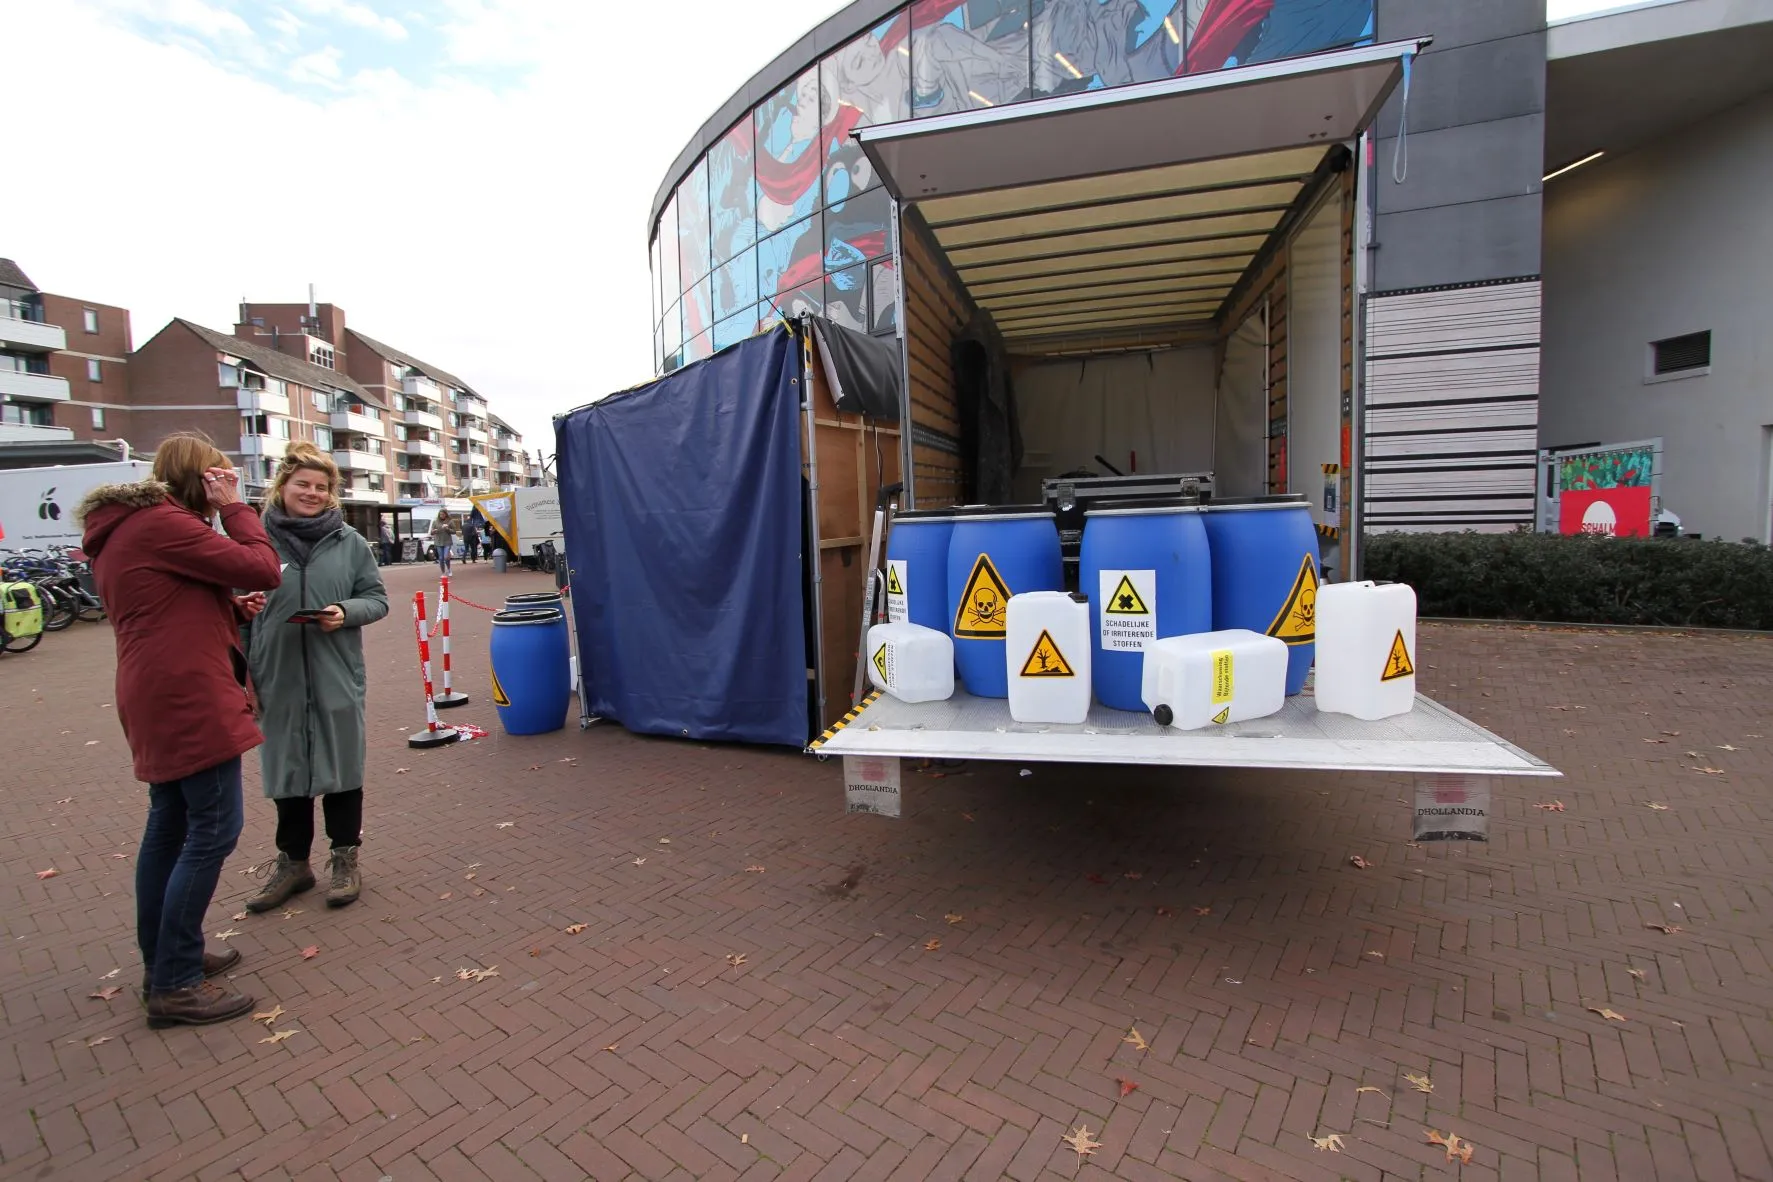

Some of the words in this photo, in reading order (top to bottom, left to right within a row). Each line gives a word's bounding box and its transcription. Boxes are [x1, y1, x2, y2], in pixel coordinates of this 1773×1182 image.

[1105, 619, 1150, 628] SCHADELIJKE
[1102, 629, 1110, 637] OF
[1111, 630, 1155, 638] IRRITERENDE
[1112, 640, 1142, 648] STOFFEN
[848, 784, 898, 794] DHOLLANDIA
[1418, 807, 1485, 817] DHOLLANDIA
